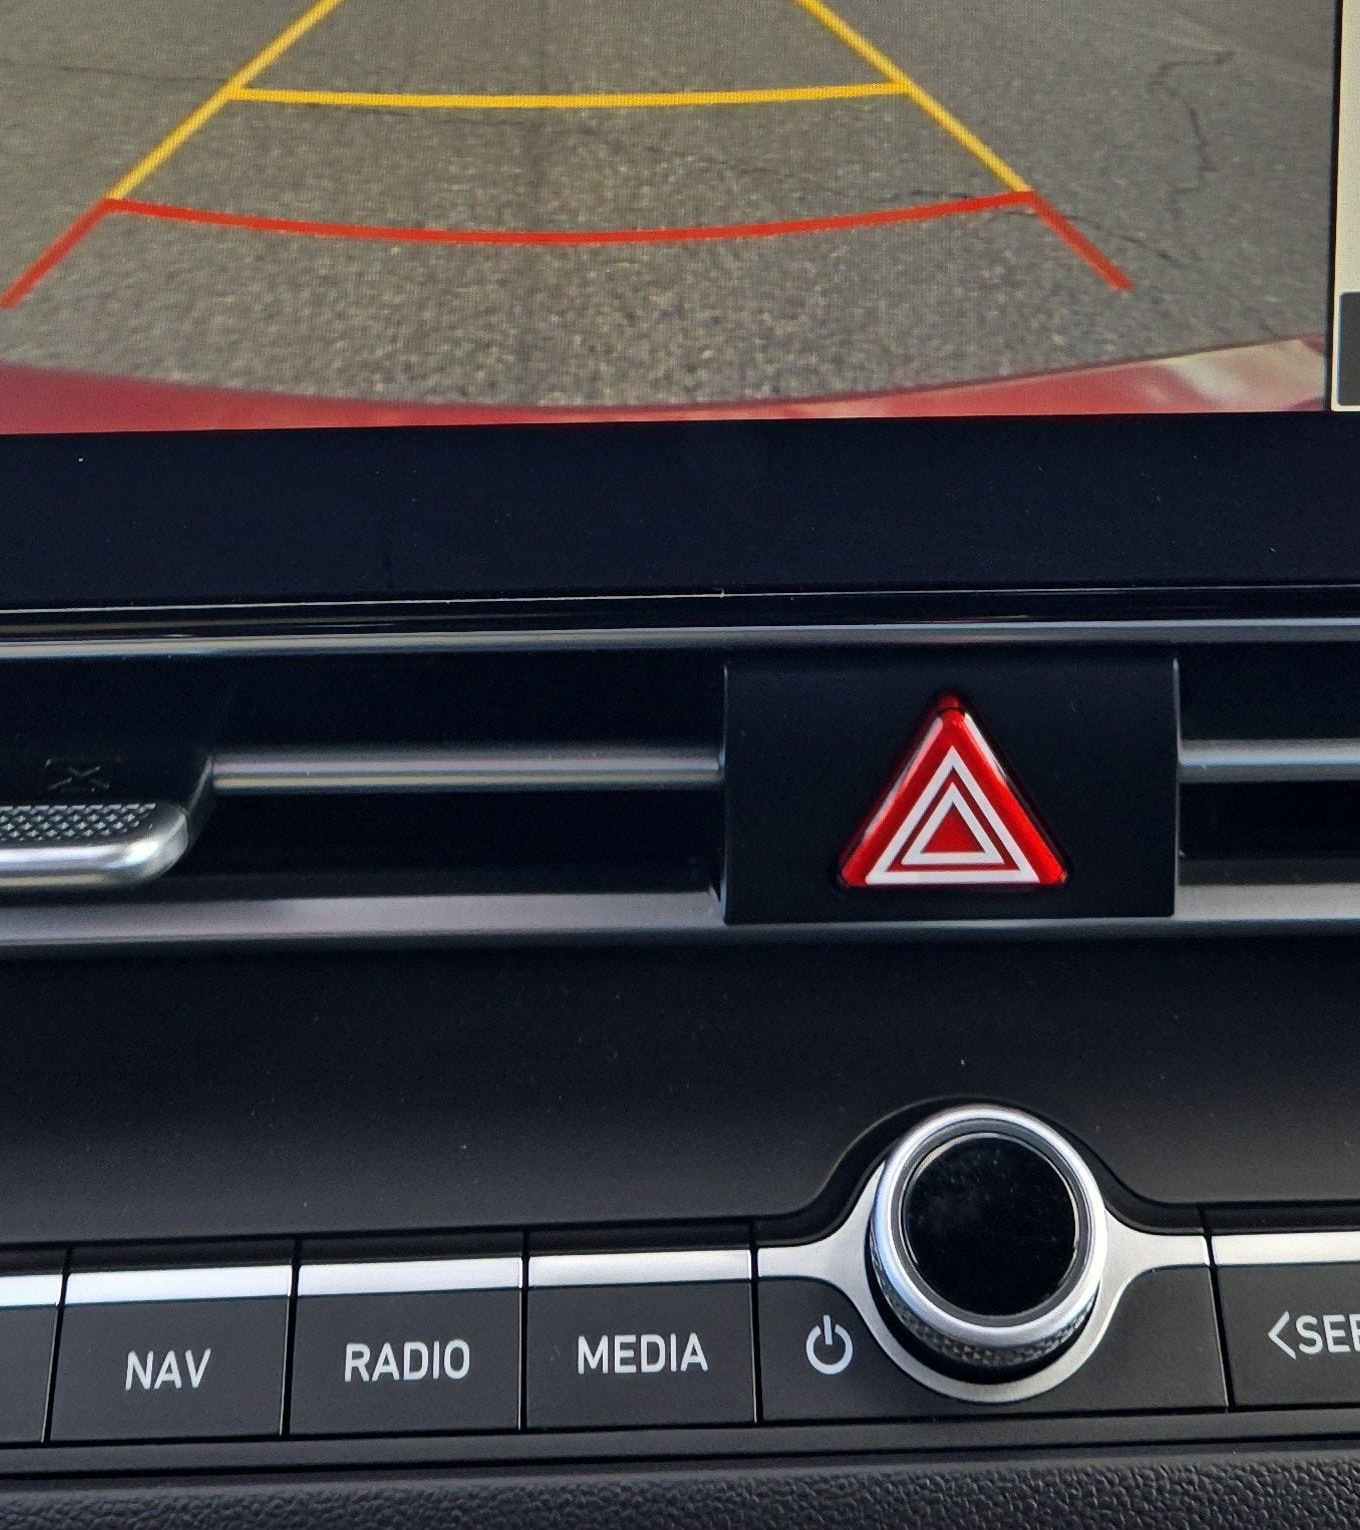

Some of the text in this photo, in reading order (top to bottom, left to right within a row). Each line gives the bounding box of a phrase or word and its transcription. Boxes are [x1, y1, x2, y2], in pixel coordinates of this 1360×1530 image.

[123, 1347, 213, 1392] NAV
[342, 1338, 472, 1383] RADIO
[575, 1332, 709, 1377] MEDIA
